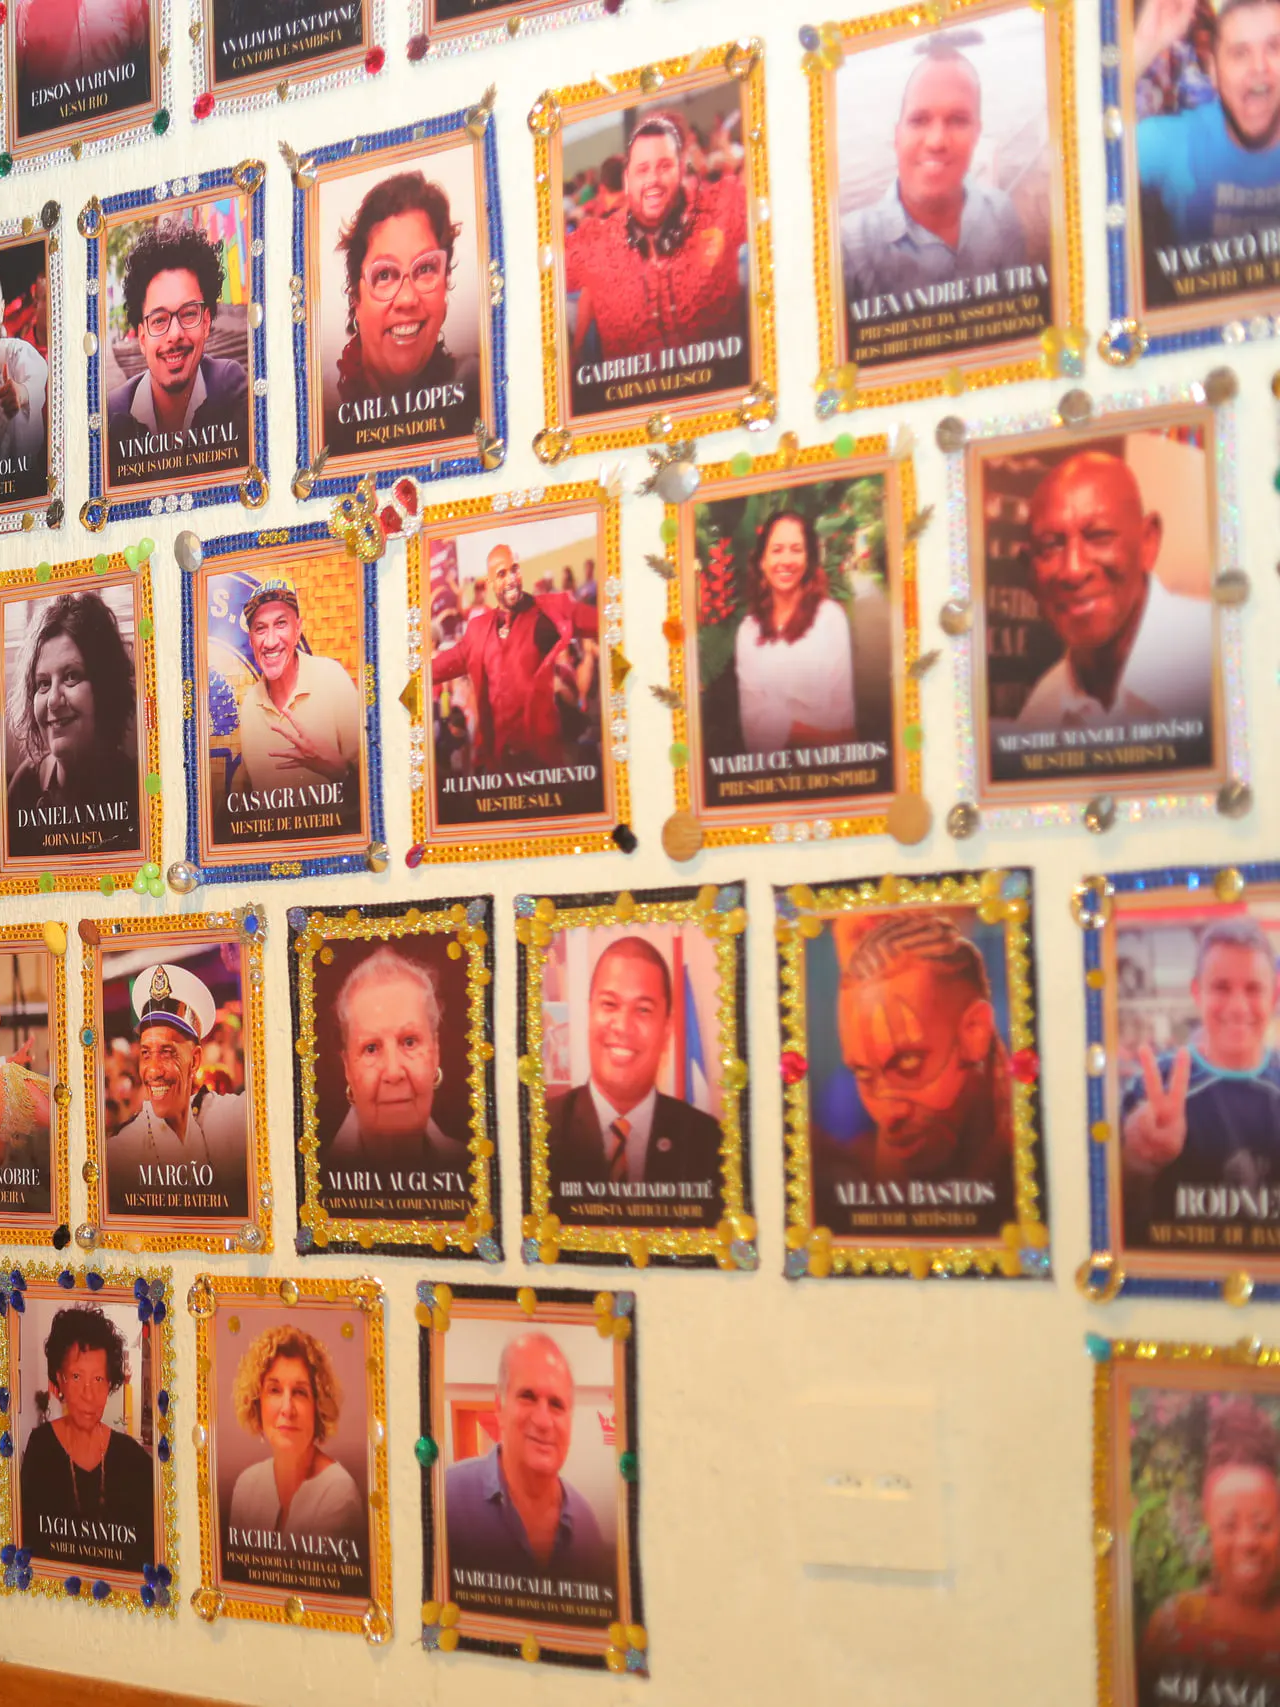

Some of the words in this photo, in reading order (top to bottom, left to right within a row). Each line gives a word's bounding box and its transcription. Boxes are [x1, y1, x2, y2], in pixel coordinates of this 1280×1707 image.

[221, 26, 282, 54] ANALIMAR
[231, 44, 282, 69] CANTORA
[283, 42, 290, 55] E
[289, 28, 343, 54] SAMBISTA
[31, 81, 72, 107] EDSON
[75, 62, 136, 95] MARINHO
[1155, 232, 1257, 274] MACACO
[849, 278, 971, 321] ALEXANDRE
[974, 263, 1049, 298] DUTRA
[576, 351, 657, 385] GABRIEL
[658, 336, 741, 371] HADDAD
[604, 368, 713, 402] CARNAVALESCO
[337, 393, 400, 424] CARLA
[404, 384, 465, 413] LOPES
[118, 430, 184, 458] VINÍCIUS
[187, 422, 239, 447] NATAL
[355, 417, 447, 444] PESQUISADORA
[117, 456, 183, 477] PESQUISADOR
[185, 448, 239, 466] ENREDISTA
[707, 750, 793, 775] MARLUCE
[441, 773, 502, 793] JULINHO
[503, 764, 597, 788] NASCIMENTO
[226, 782, 344, 813] CASAGRANDE
[17, 805, 81, 828] DANIELA
[85, 801, 129, 823] NAME
[229, 818, 275, 835] MESTRE
[276, 817, 293, 831] DE
[293, 813, 343, 830] BATERIA
[41, 831, 103, 847] JORNALISTA
[138, 1160, 214, 1186] MARCÃO
[327, 1171, 383, 1190] MARIA
[389, 1171, 465, 1191] AUGUSTA
[123, 1194, 167, 1206] MESTRE
[167, 1194, 183, 1207] DE
[183, 1194, 229, 1207] BATERIA
[559, 1182, 606, 1198] BRUNO
[606, 1182, 677, 1199] MACHADO
[834, 1182, 905, 1205] ALLAN
[907, 1182, 997, 1205] BASTOS
[39, 1515, 79, 1537] LYGIA
[80, 1520, 137, 1544] SANTOS
[229, 1527, 287, 1551] RACHEL
[289, 1534, 359, 1562] VALENÇA
[452, 1568, 515, 1590] MARCELO
[559, 1580, 613, 1602] PETRUS
